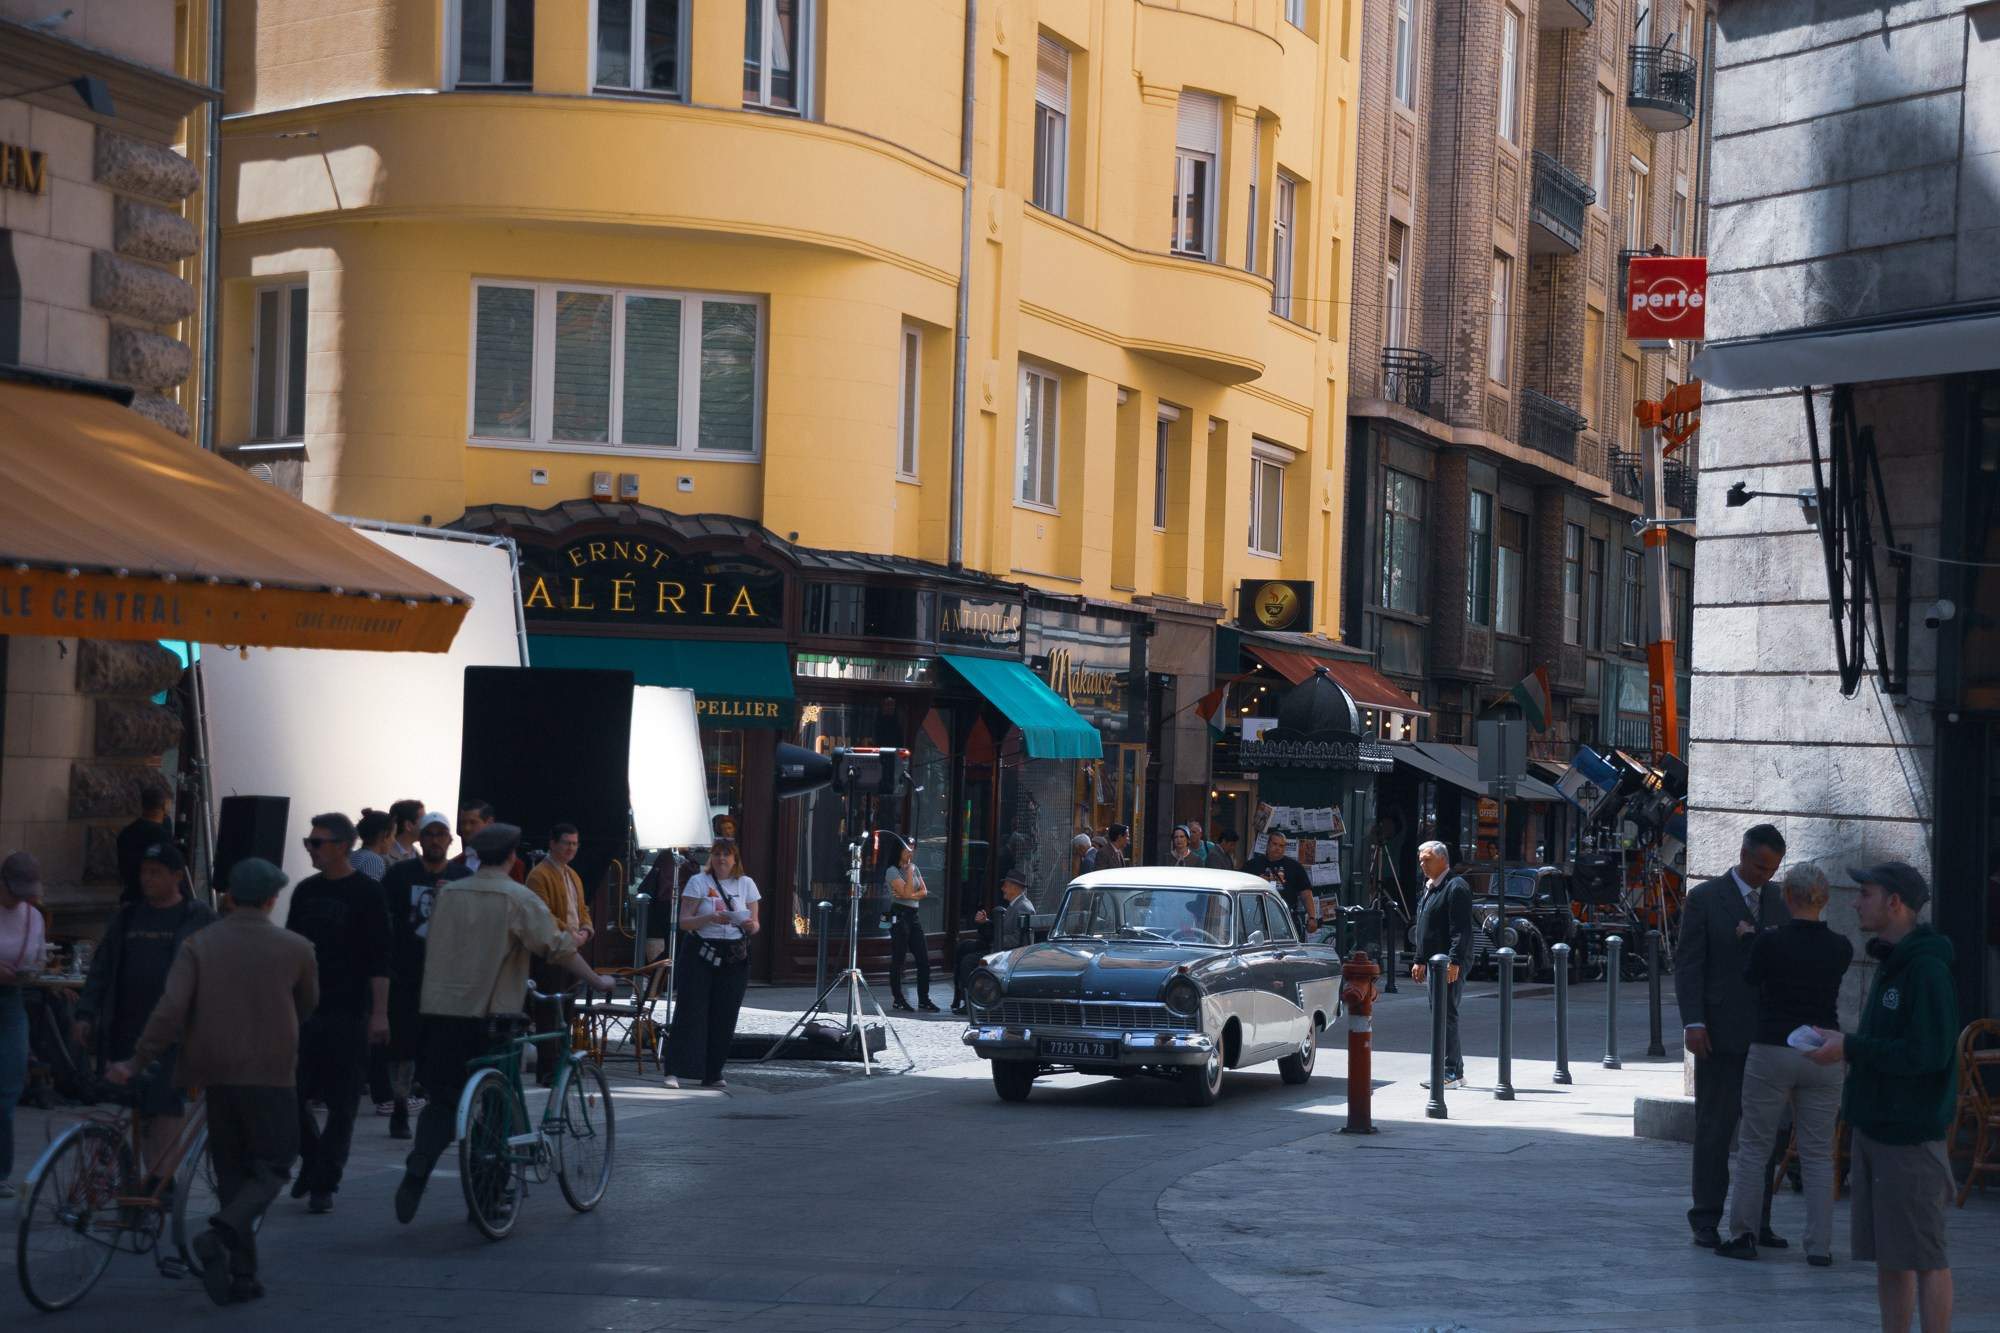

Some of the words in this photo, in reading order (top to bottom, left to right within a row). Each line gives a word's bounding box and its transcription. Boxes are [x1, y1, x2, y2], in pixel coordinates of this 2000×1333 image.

[568, 541, 669, 569] ERNST
[1, 585, 32, 617] LE
[52, 588, 182, 625] CENTRAL
[523, 572, 759, 617] ALÉRIA
[941, 607, 1018, 643] ANTIQUES
[1048, 647, 1114, 707] Makausz
[695, 700, 779, 717] PELLIER
[1480, 808, 1499, 818] OFFERS
[1050, 1041, 1074, 1054] 7732
[1078, 1042, 1089, 1055] TA
[1093, 1043, 1105, 1056] 78
